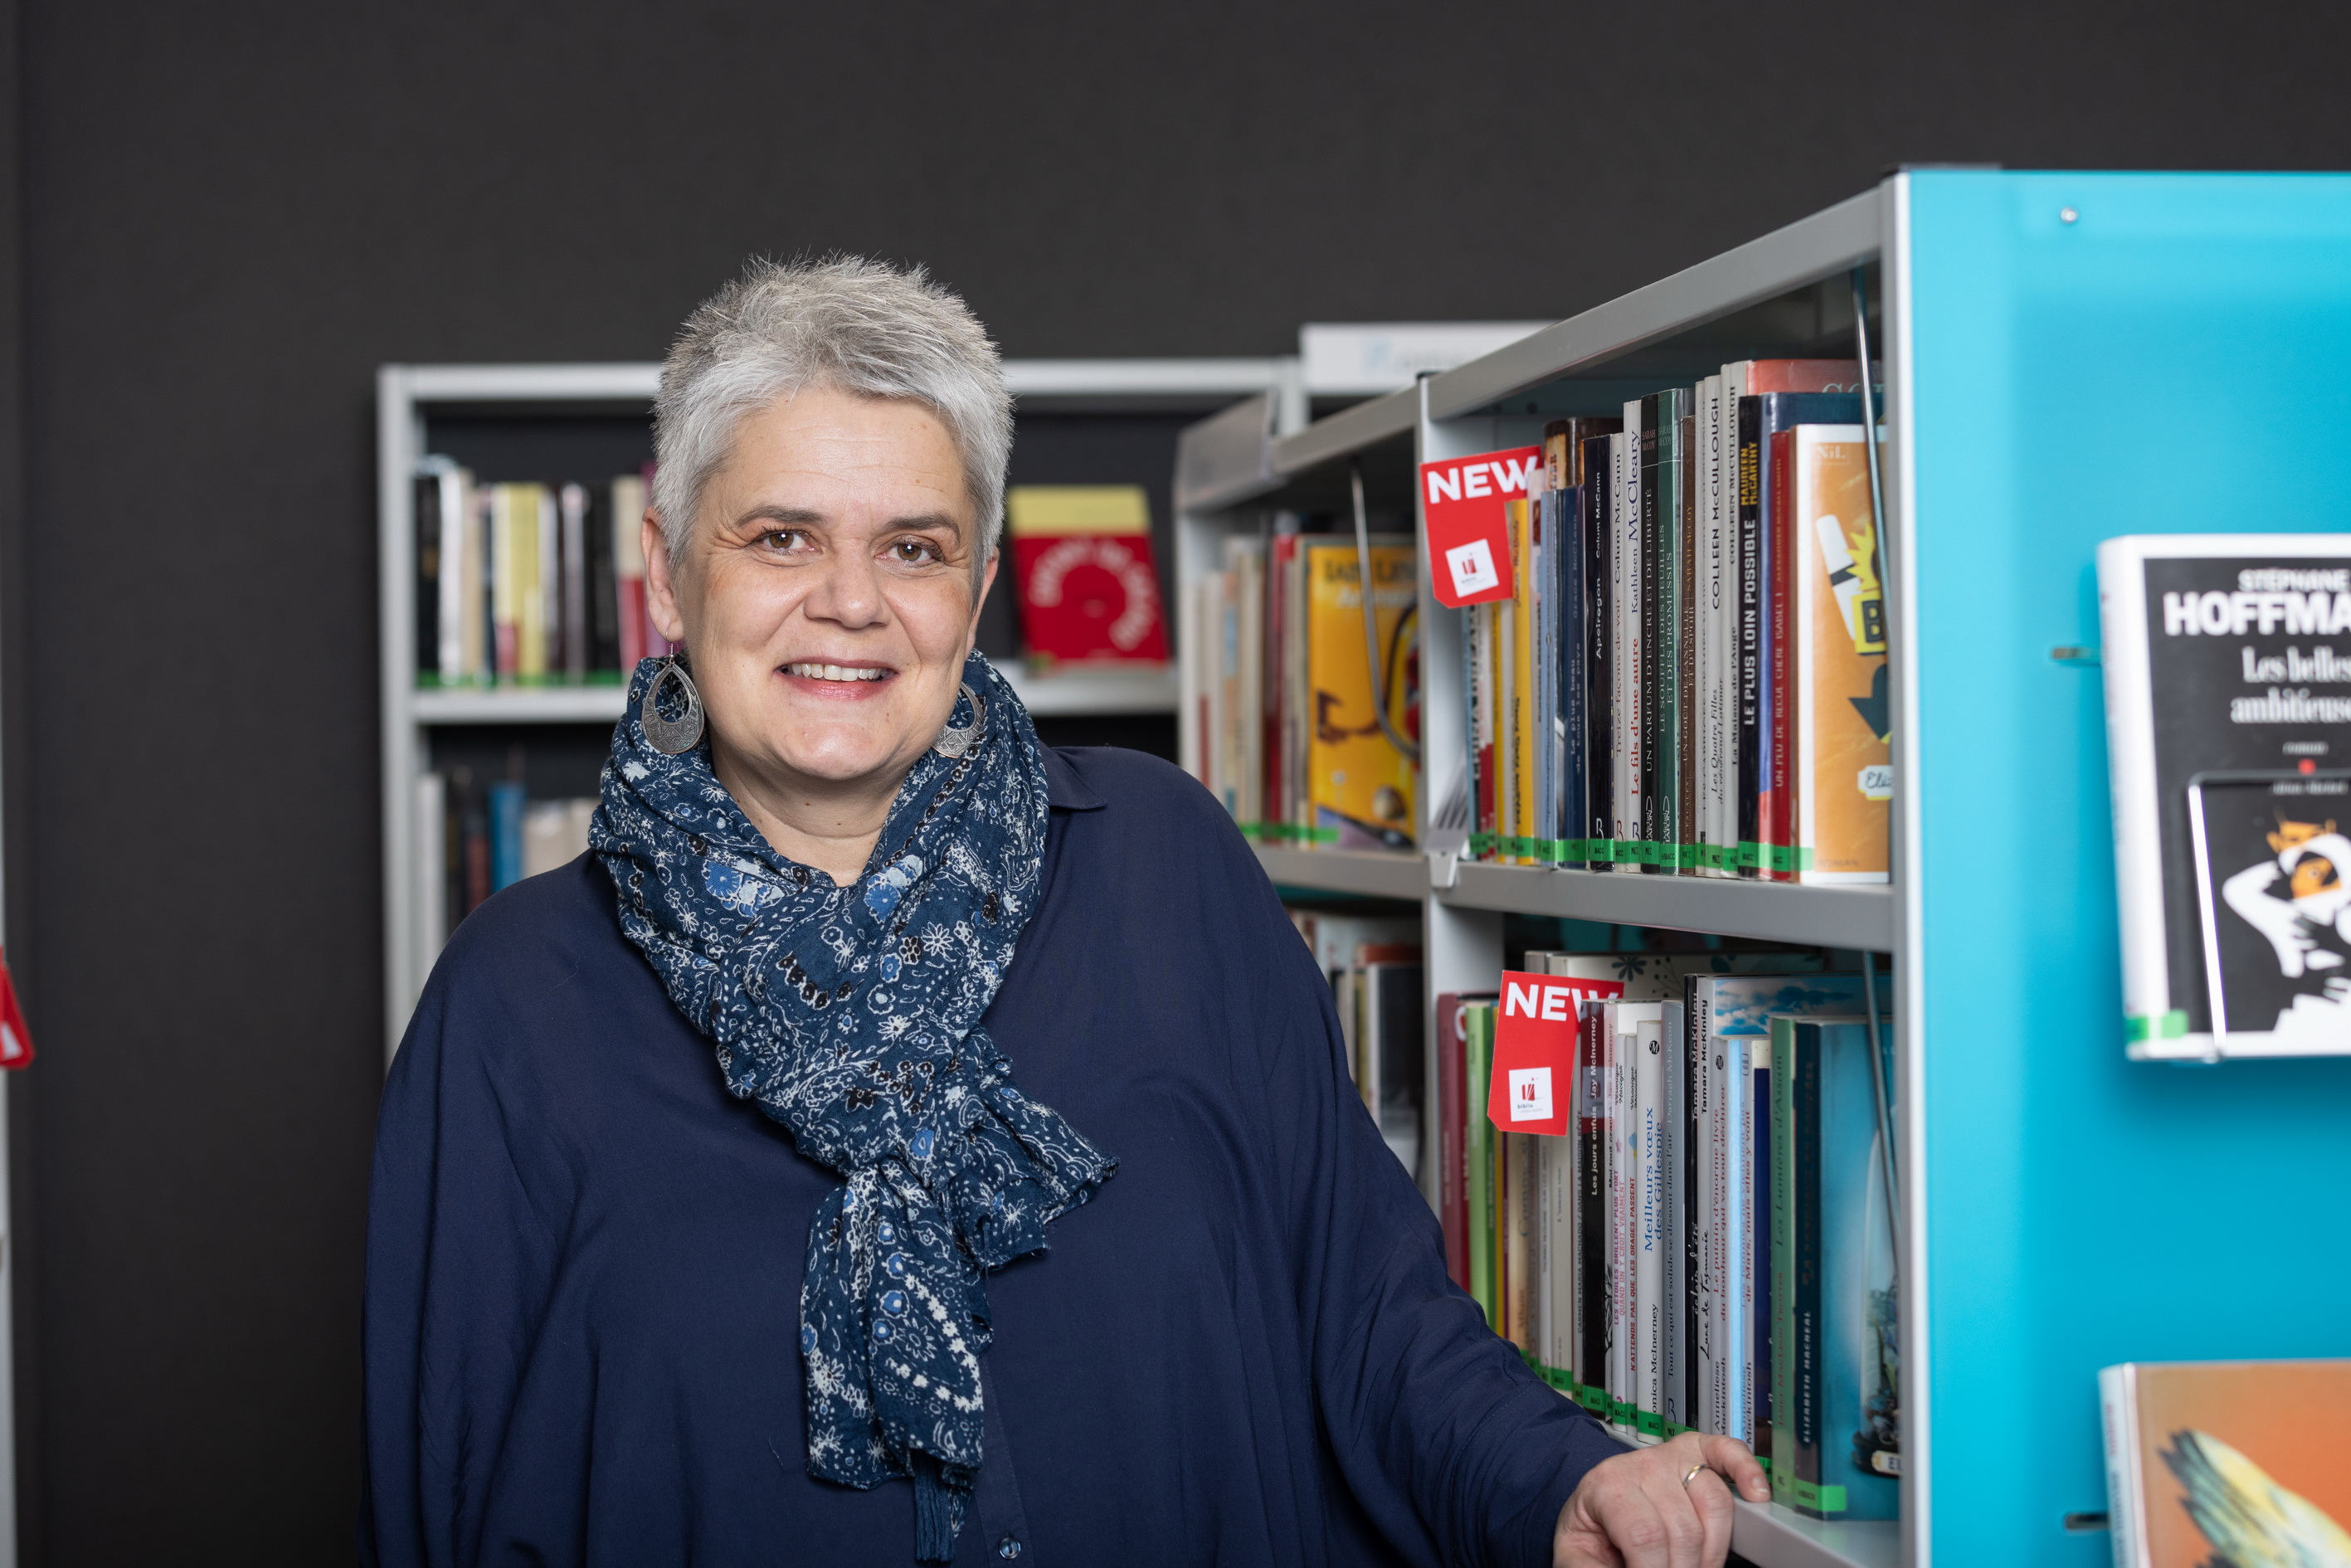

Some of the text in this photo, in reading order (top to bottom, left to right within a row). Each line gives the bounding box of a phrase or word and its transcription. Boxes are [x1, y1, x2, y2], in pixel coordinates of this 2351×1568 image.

[1642, 428, 1656, 441] SARAH
[1657, 424, 1672, 436] SARAH
[1642, 441, 1656, 451] McCOY
[1711, 397, 1720, 520] McCULLOUGH
[1427, 455, 1538, 504] NEW
[1740, 447, 1749, 506] MAUREEN
[1627, 429, 1640, 614] Kathleen McCleary
[1646, 558, 1653, 578] DE
[1646, 585, 1653, 597] ET
[1743, 519, 1756, 726] LE PLUS LOIN POSSIBLE
[1774, 602, 1784, 640] ISABEL
[1615, 631, 1621, 650] de
[2241, 645, 2288, 683] Les
[1683, 681, 1688, 698] DE
[1731, 674, 1737, 690] de
[1667, 685, 1672, 704] ET
[1630, 689, 1638, 737] d'une
[1660, 713, 1665, 732] LE
[1774, 724, 1784, 739] DE
[1630, 742, 1638, 768] fils
[1682, 743, 1688, 762] UN
[1711, 724, 1719, 768] Quatre
[1774, 743, 1784, 766] PEU
[1646, 750, 1653, 772] UN
[1732, 748, 1738, 766] La
[1631, 773, 1639, 796] Le
[1774, 770, 1784, 787] UN
[1654, 1122, 1662, 1204] Gillespie
[1721, 1186, 1726, 1202] va
[1644, 1164, 1653, 1252] Meilleurs
[1668, 1239, 1673, 1252] se
[1618, 1271, 1625, 1283] ON
[1713, 1274, 1719, 1293] Le
[1699, 1230, 1711, 1360] Lune de Tasmanie
[1745, 1285, 1751, 1303] de
[1721, 1303, 1726, 1322] du
[1650, 1303, 1658, 1374] McInerney
[1668, 1334, 1674, 1348] ce
[1803, 1374, 1811, 1444] ELIZABETH
